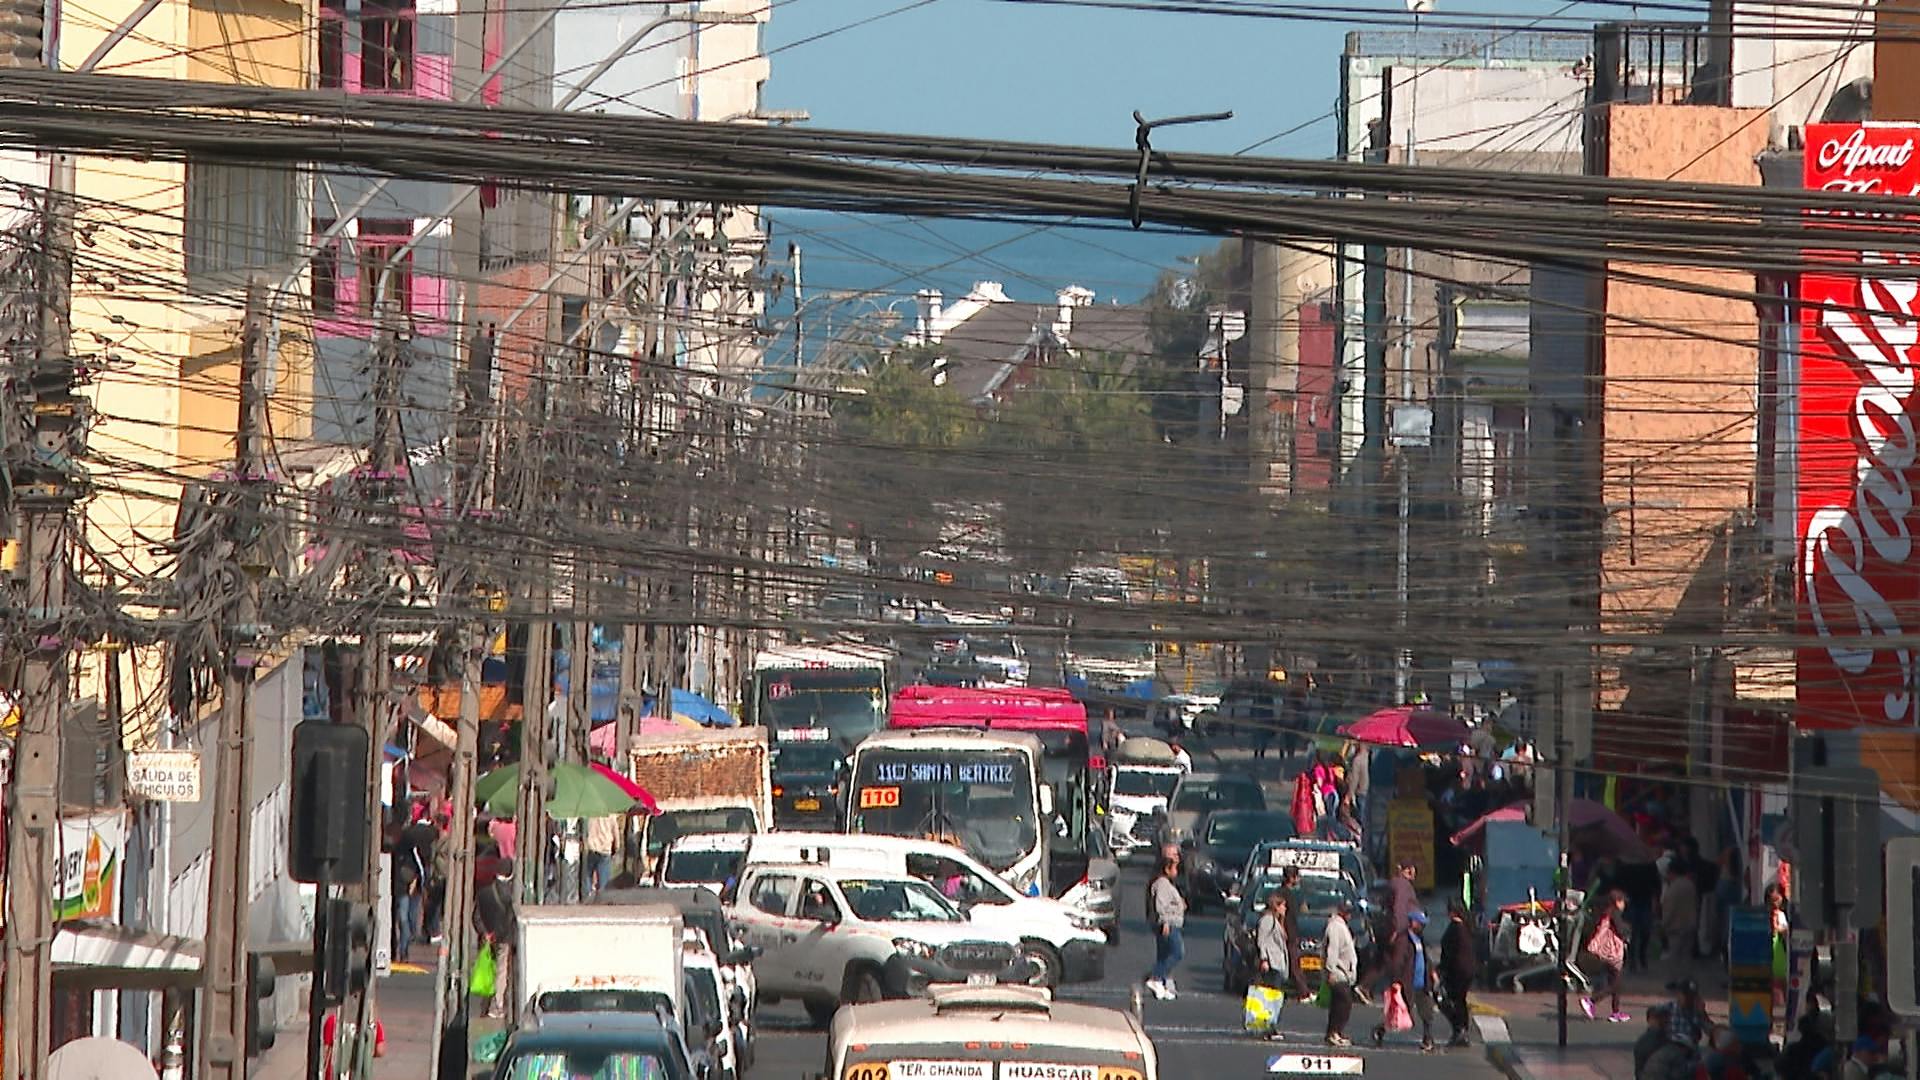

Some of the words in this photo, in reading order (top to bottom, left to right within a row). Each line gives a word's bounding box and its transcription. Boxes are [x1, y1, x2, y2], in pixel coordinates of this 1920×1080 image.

[132, 769, 173, 782] SALIDA
[178, 770, 193, 782] DE
[910, 763, 952, 783] SANTA
[958, 763, 1014, 783] BEATRIZ
[863, 791, 897, 805] 110
